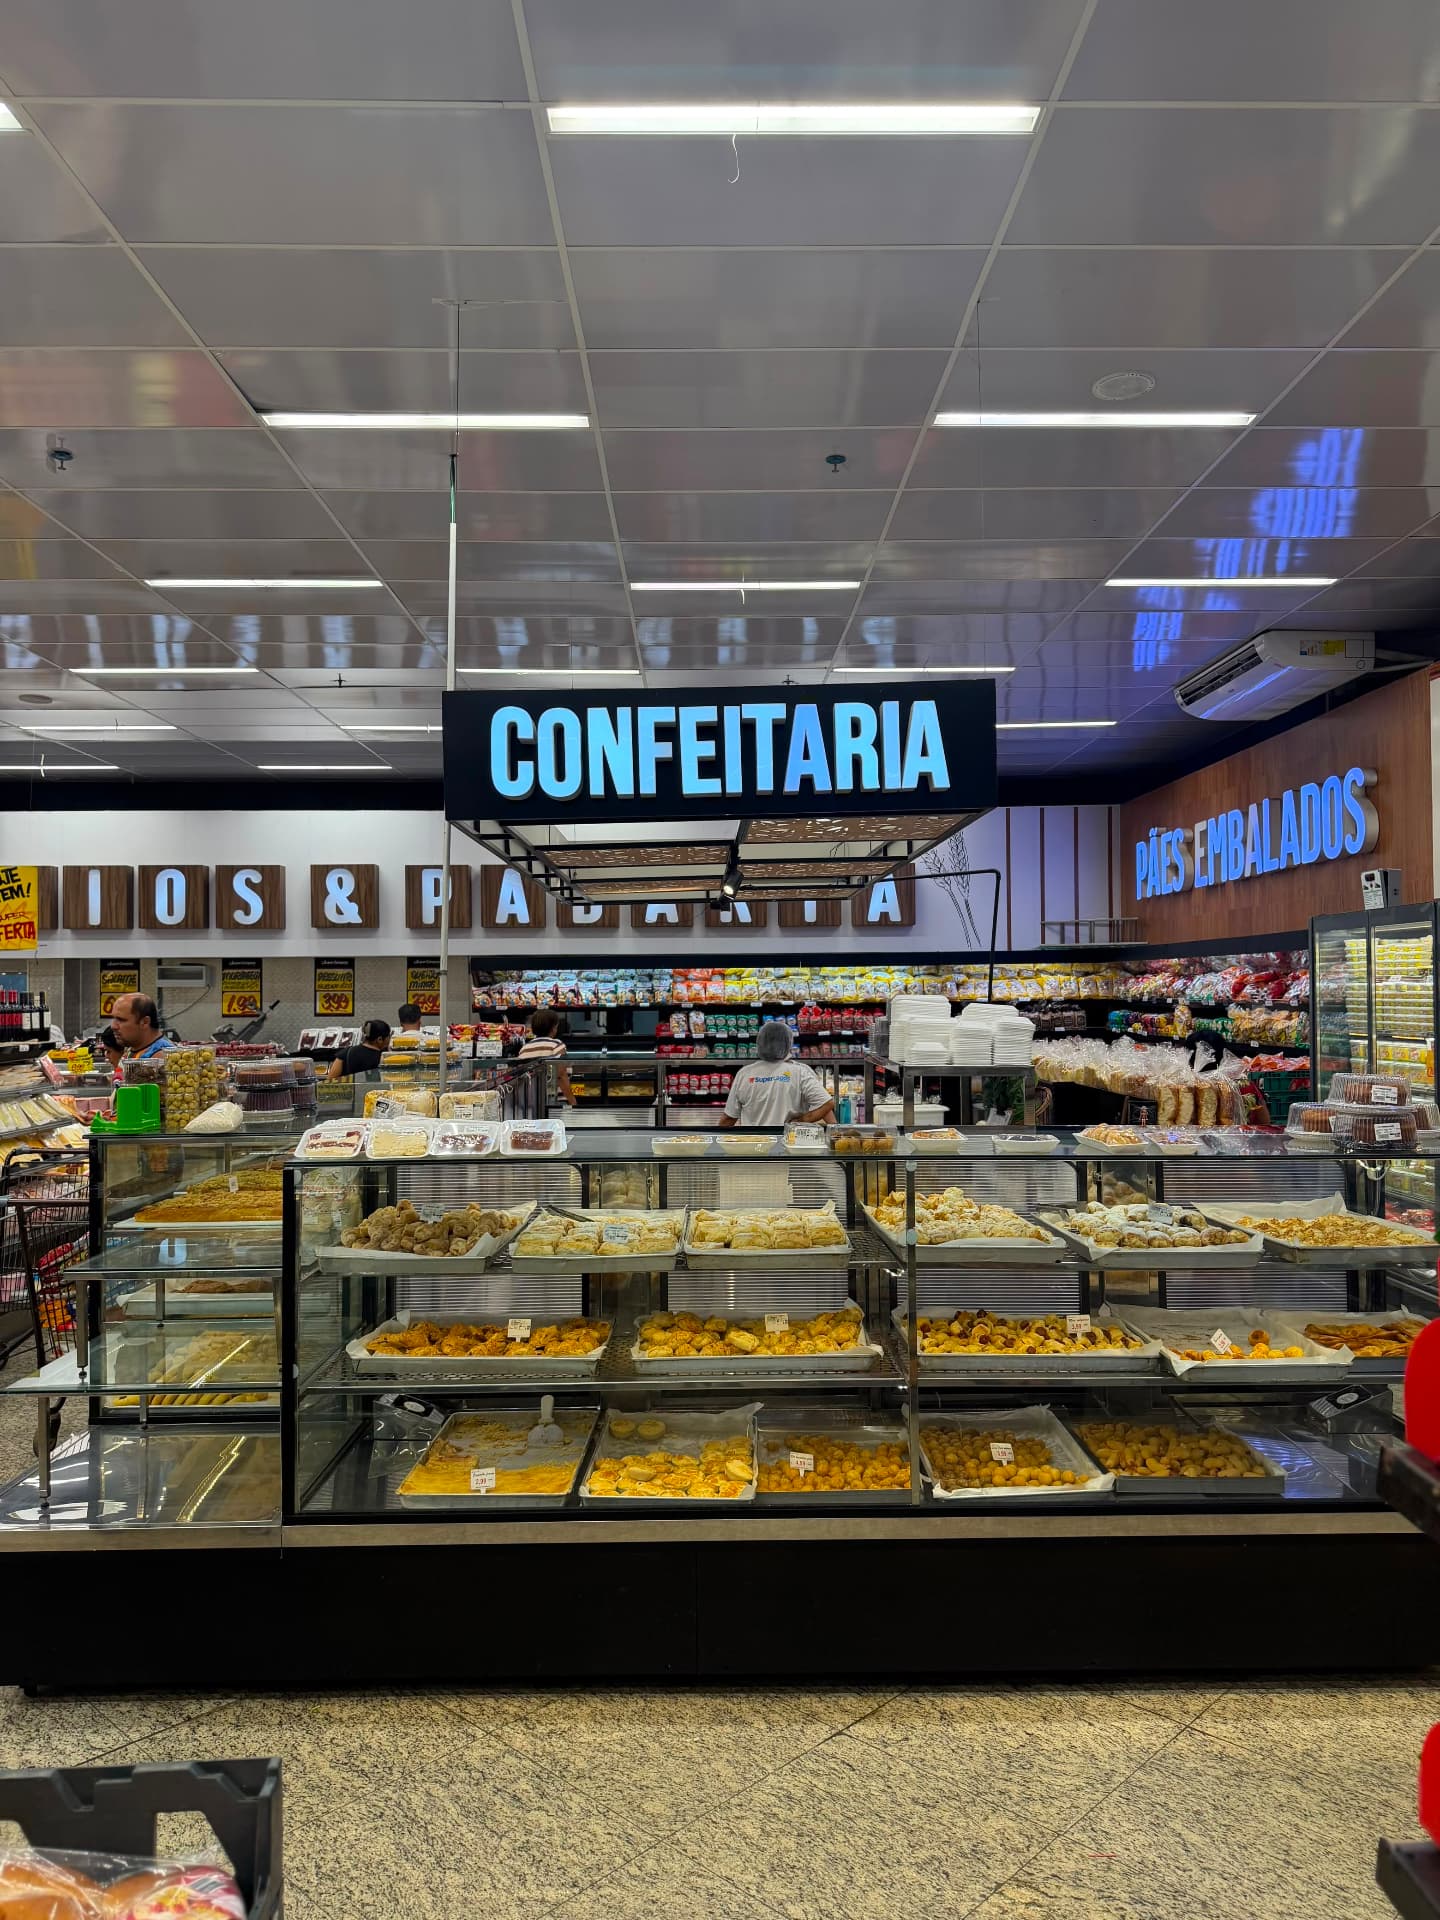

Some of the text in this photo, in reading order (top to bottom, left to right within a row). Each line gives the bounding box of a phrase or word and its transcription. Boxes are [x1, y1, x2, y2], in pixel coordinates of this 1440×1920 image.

[490, 700, 950, 799] CONFEITARIA
[1135, 767, 1368, 901] PÃES EMBALADOS
[0, 882, 32, 903] EM!
